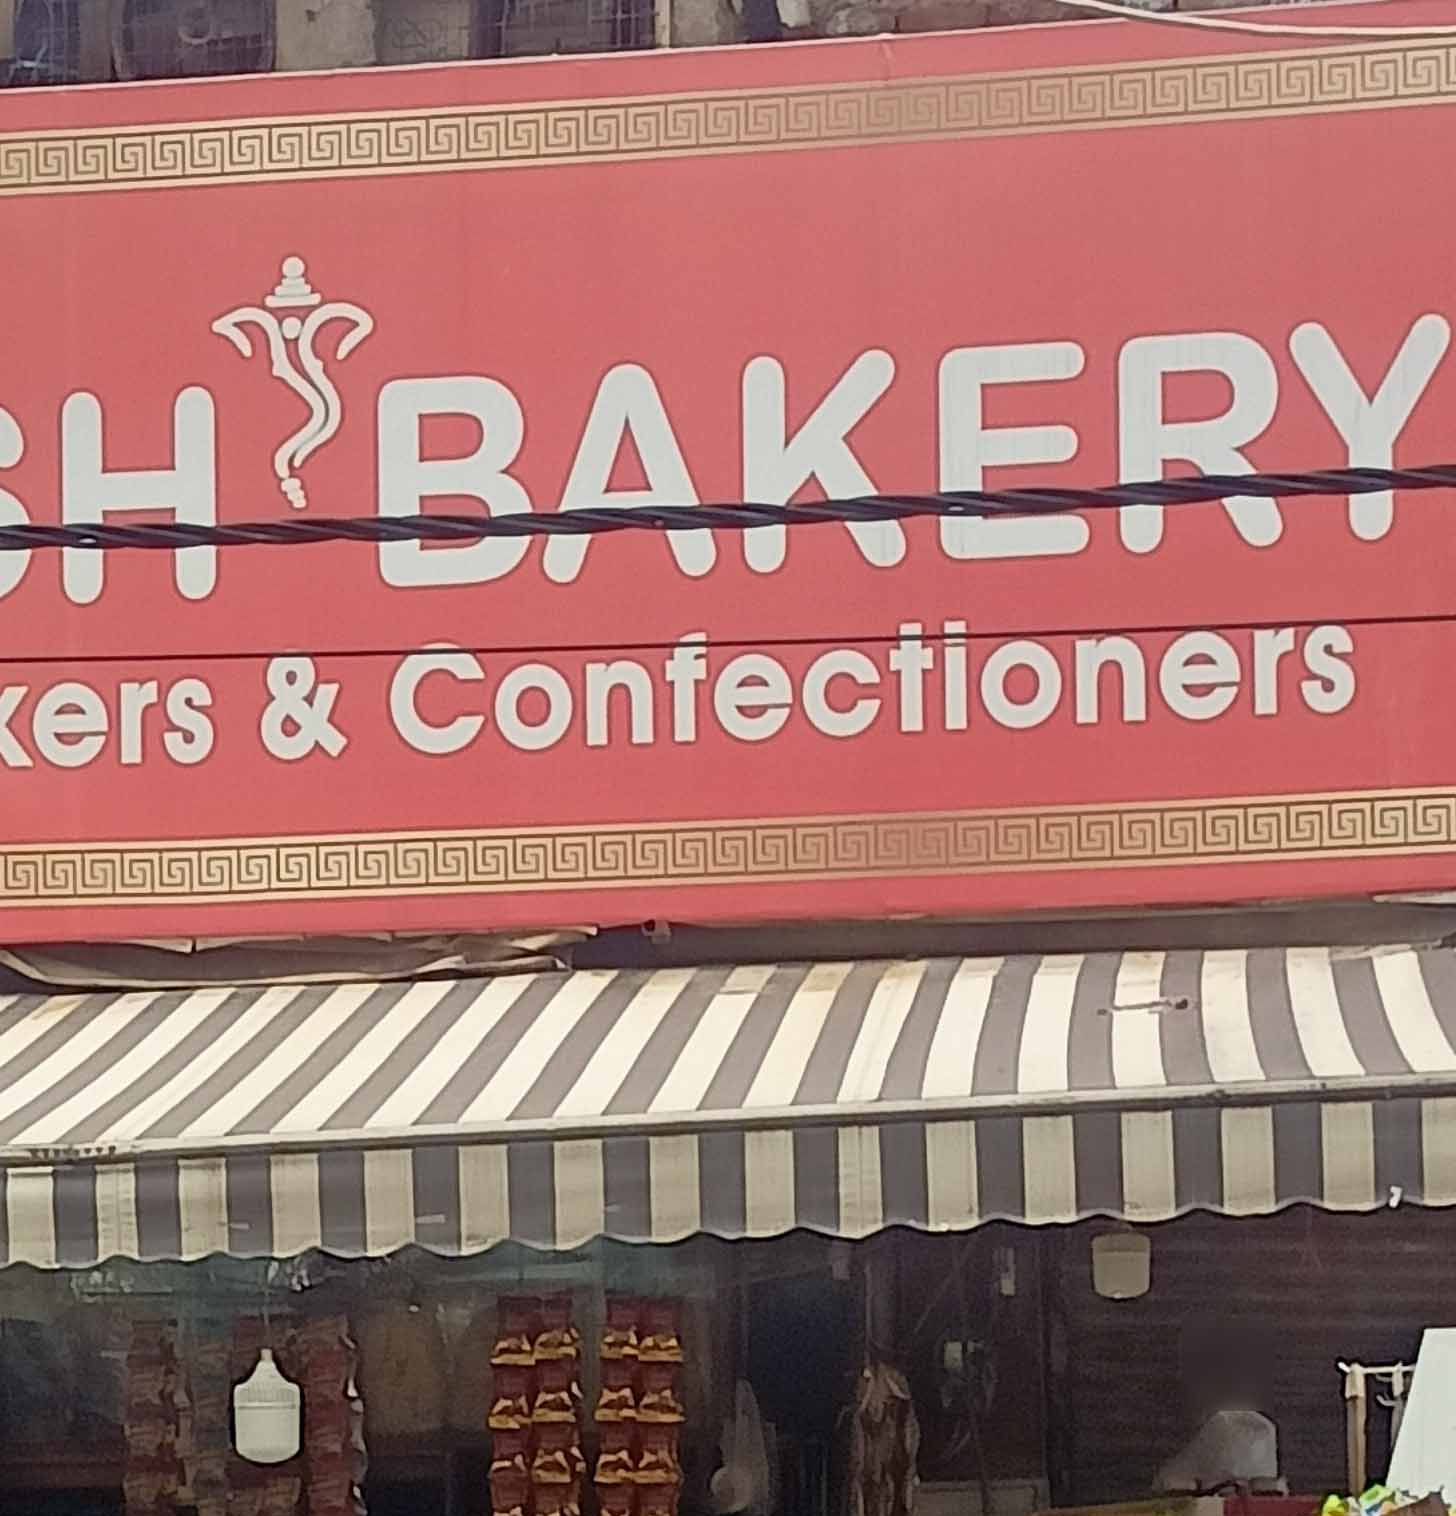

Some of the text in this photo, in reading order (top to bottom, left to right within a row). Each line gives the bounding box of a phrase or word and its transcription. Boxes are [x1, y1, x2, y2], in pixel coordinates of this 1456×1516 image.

[376, 312, 1452, 588] BAKERY
[259, 652, 348, 761] &
[389, 620, 1357, 754] Confectioners
